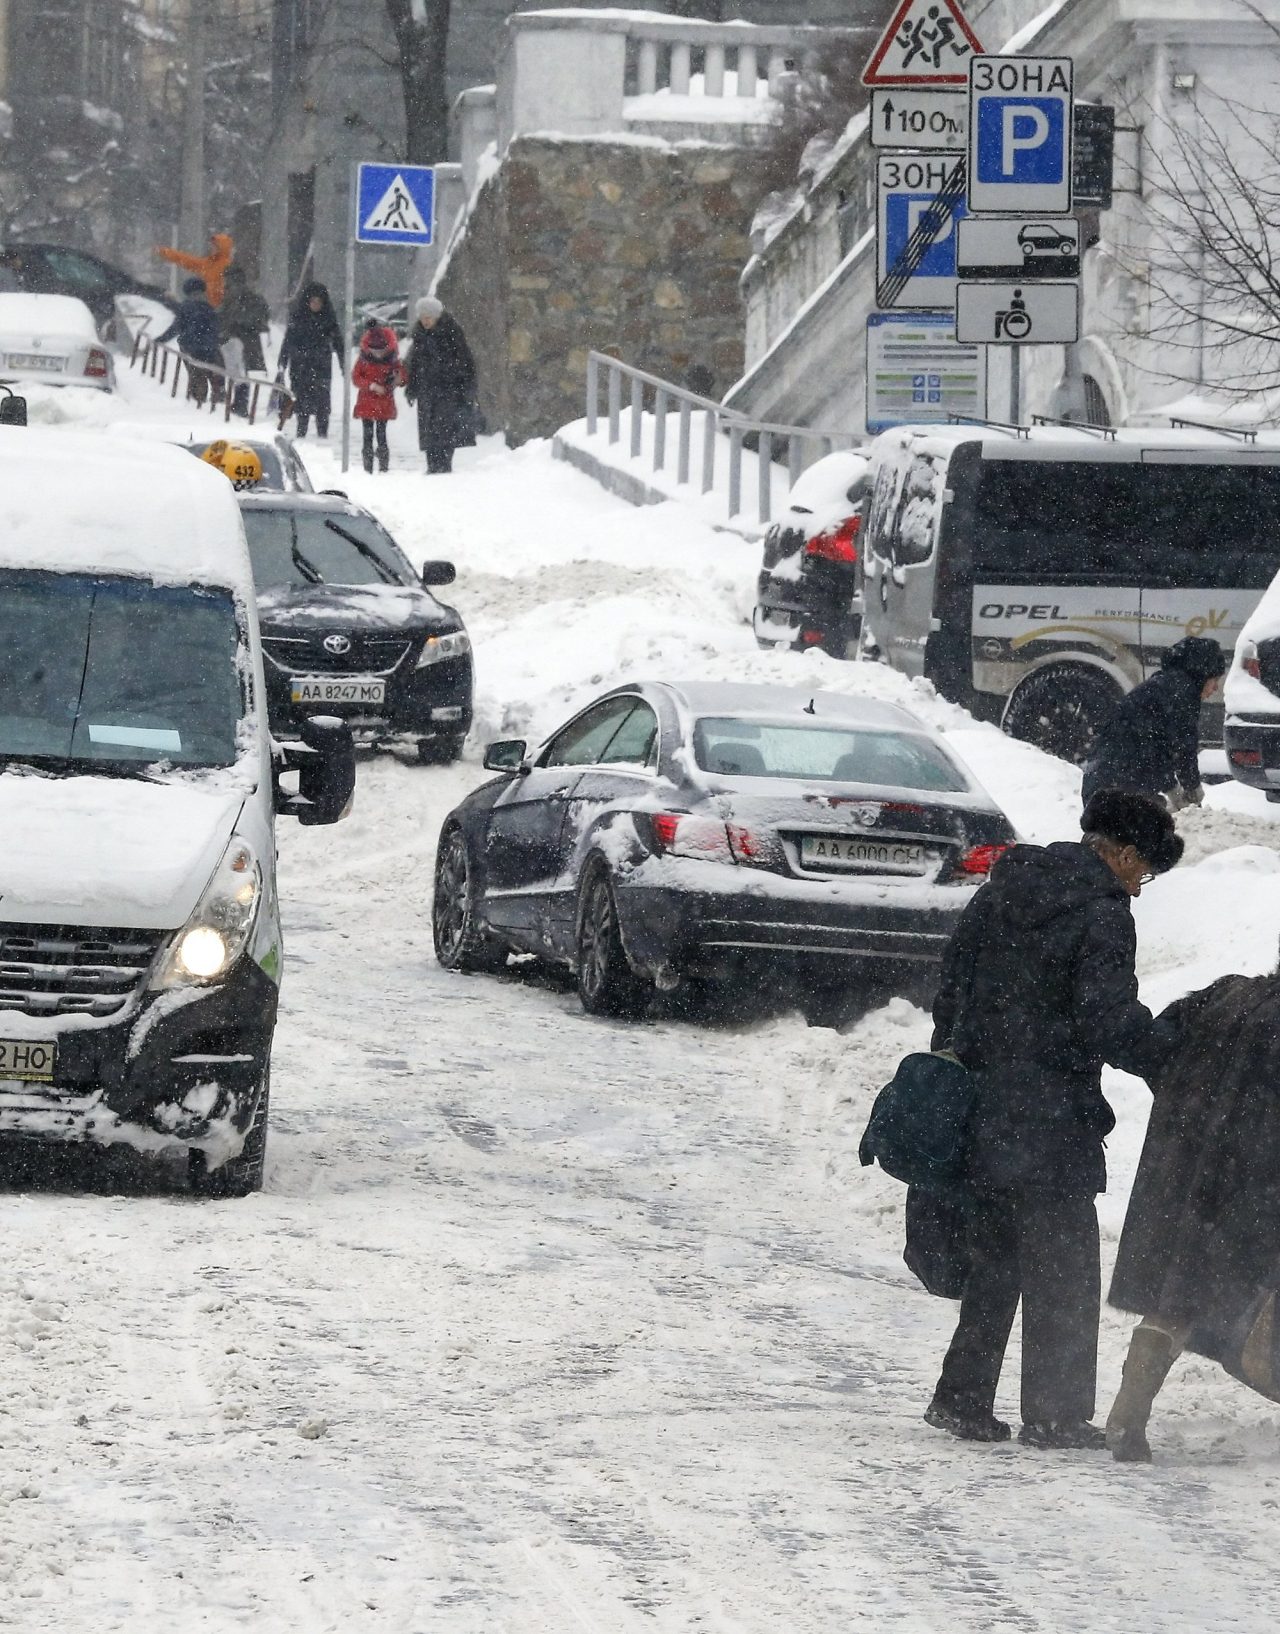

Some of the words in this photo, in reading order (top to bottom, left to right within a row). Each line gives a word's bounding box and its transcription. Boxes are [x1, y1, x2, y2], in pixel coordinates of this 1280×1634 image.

[974, 64, 1069, 92] ЗОНА
[1002, 105, 1049, 175] P
[882, 162, 966, 190] ЗОН
[235, 465, 254, 477] 432
[979, 604, 1068, 620] OPEL
[1095, 609, 1181, 623] PERFORMANCE
[301, 687, 322, 699] AA
[325, 687, 357, 699] 8247
[360, 687, 381, 699] MO
[816, 842, 841, 859] AA
[13, 1046, 47, 1069] HO
